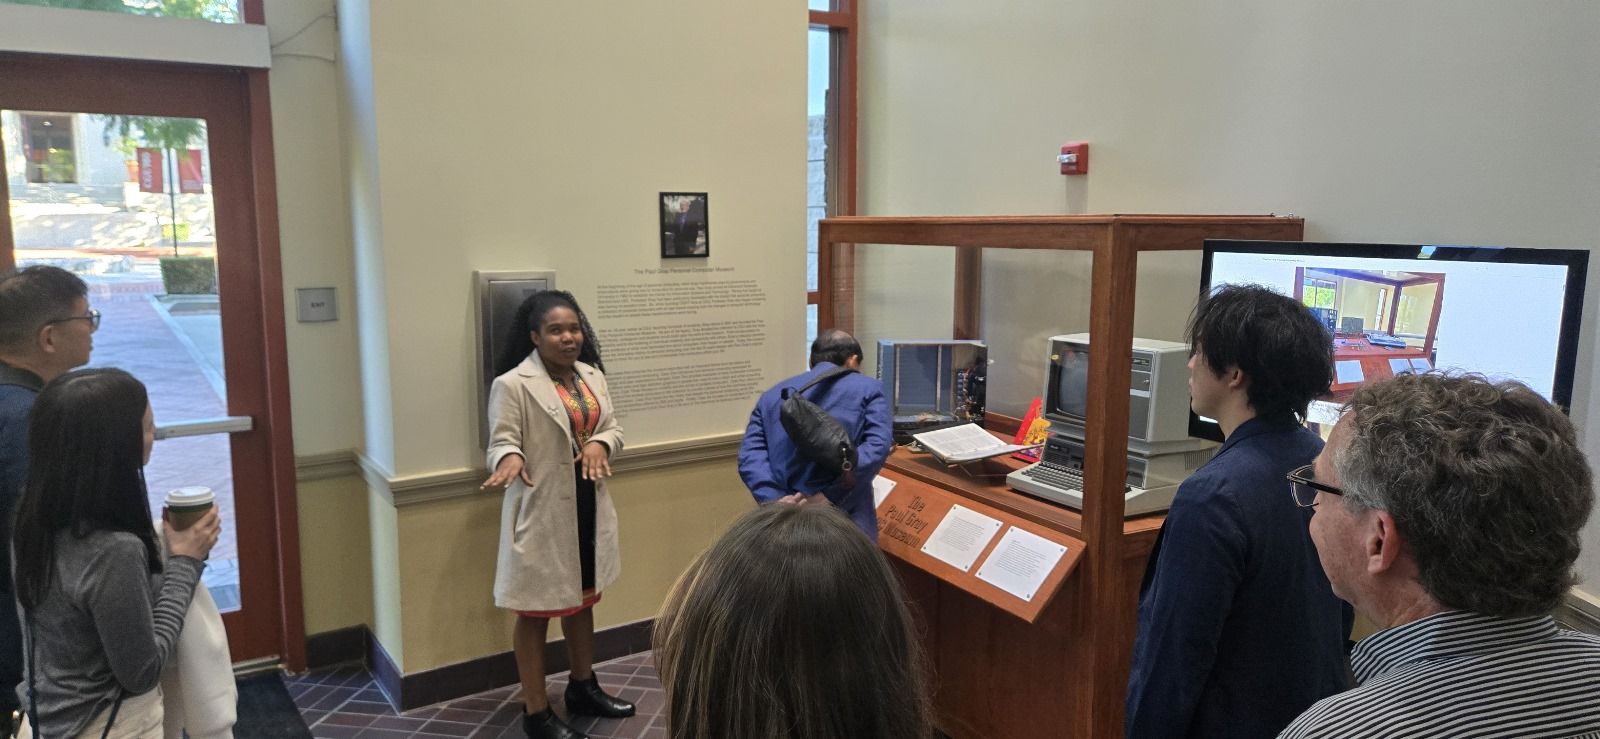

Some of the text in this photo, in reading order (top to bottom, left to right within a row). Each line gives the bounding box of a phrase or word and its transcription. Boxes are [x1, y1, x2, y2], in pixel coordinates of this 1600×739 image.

[907, 495, 926, 512] The
[884, 503, 909, 523] Paul
[904, 511, 928, 534] Gray
